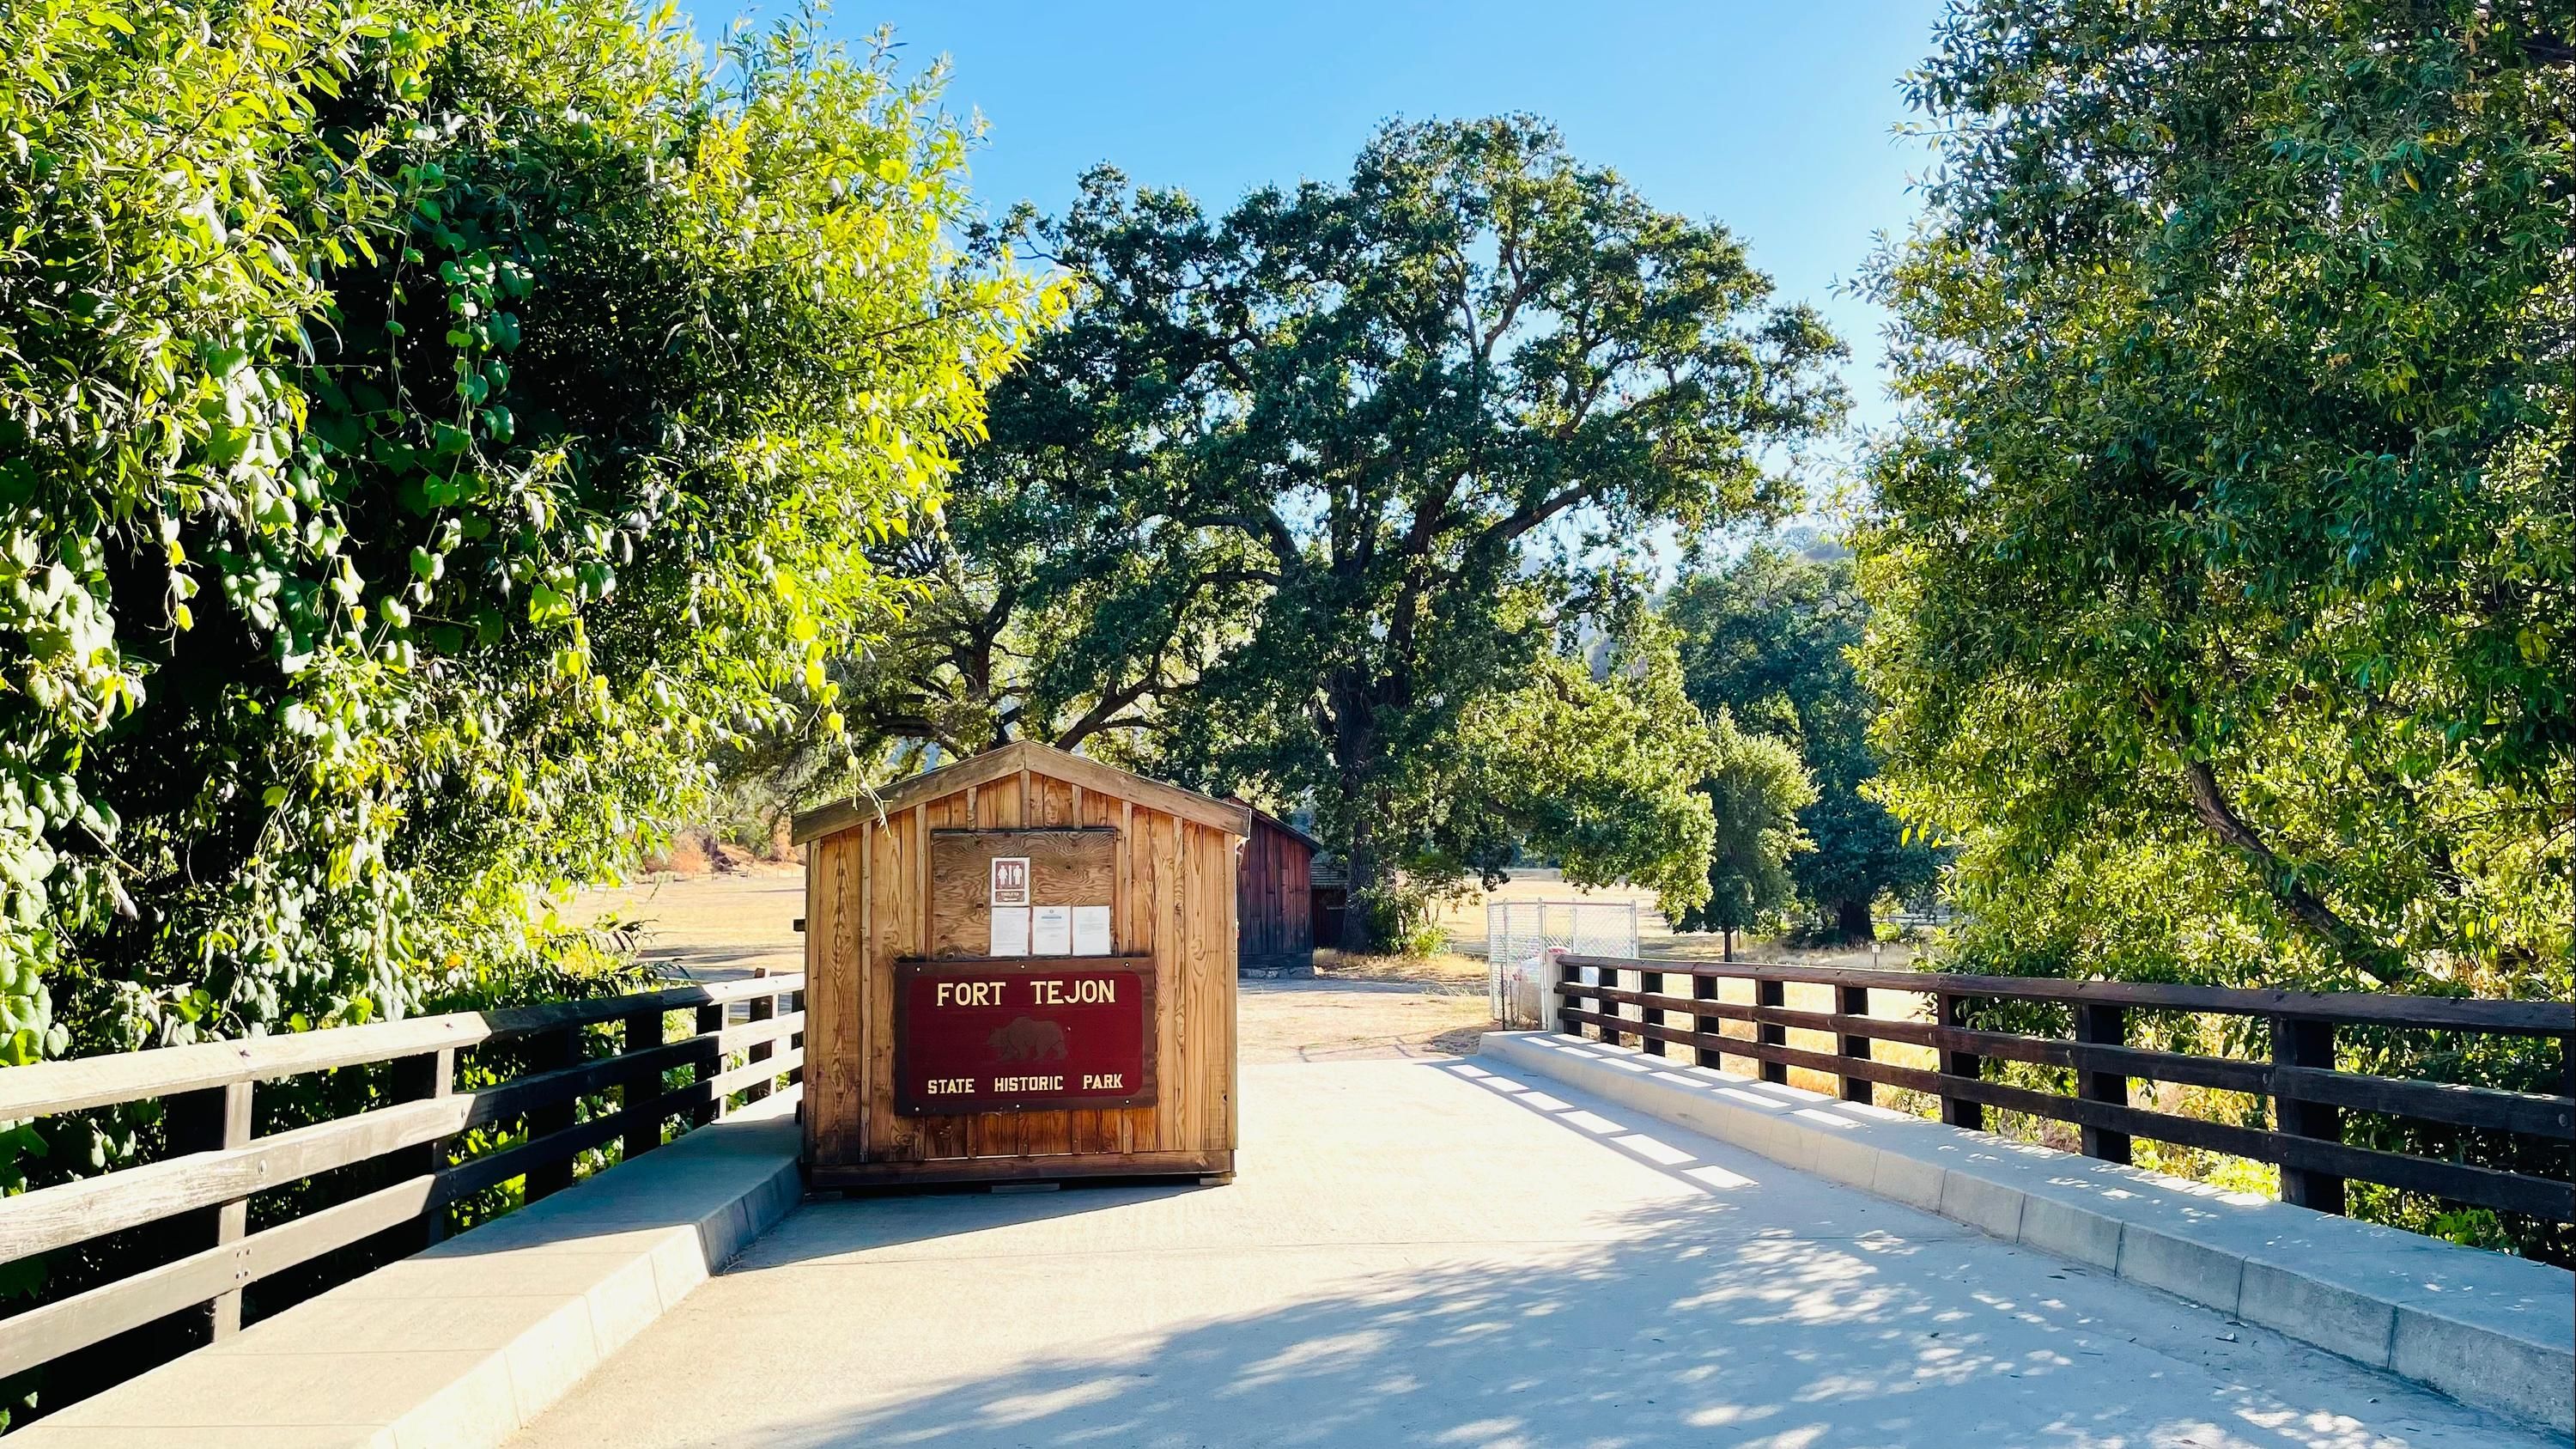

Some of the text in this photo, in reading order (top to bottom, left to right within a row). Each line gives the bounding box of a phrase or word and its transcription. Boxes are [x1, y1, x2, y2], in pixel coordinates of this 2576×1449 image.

[937, 980, 1115, 1006] FORT TEJON
[928, 1074, 1123, 1094] STATE HISTORIC PARK
